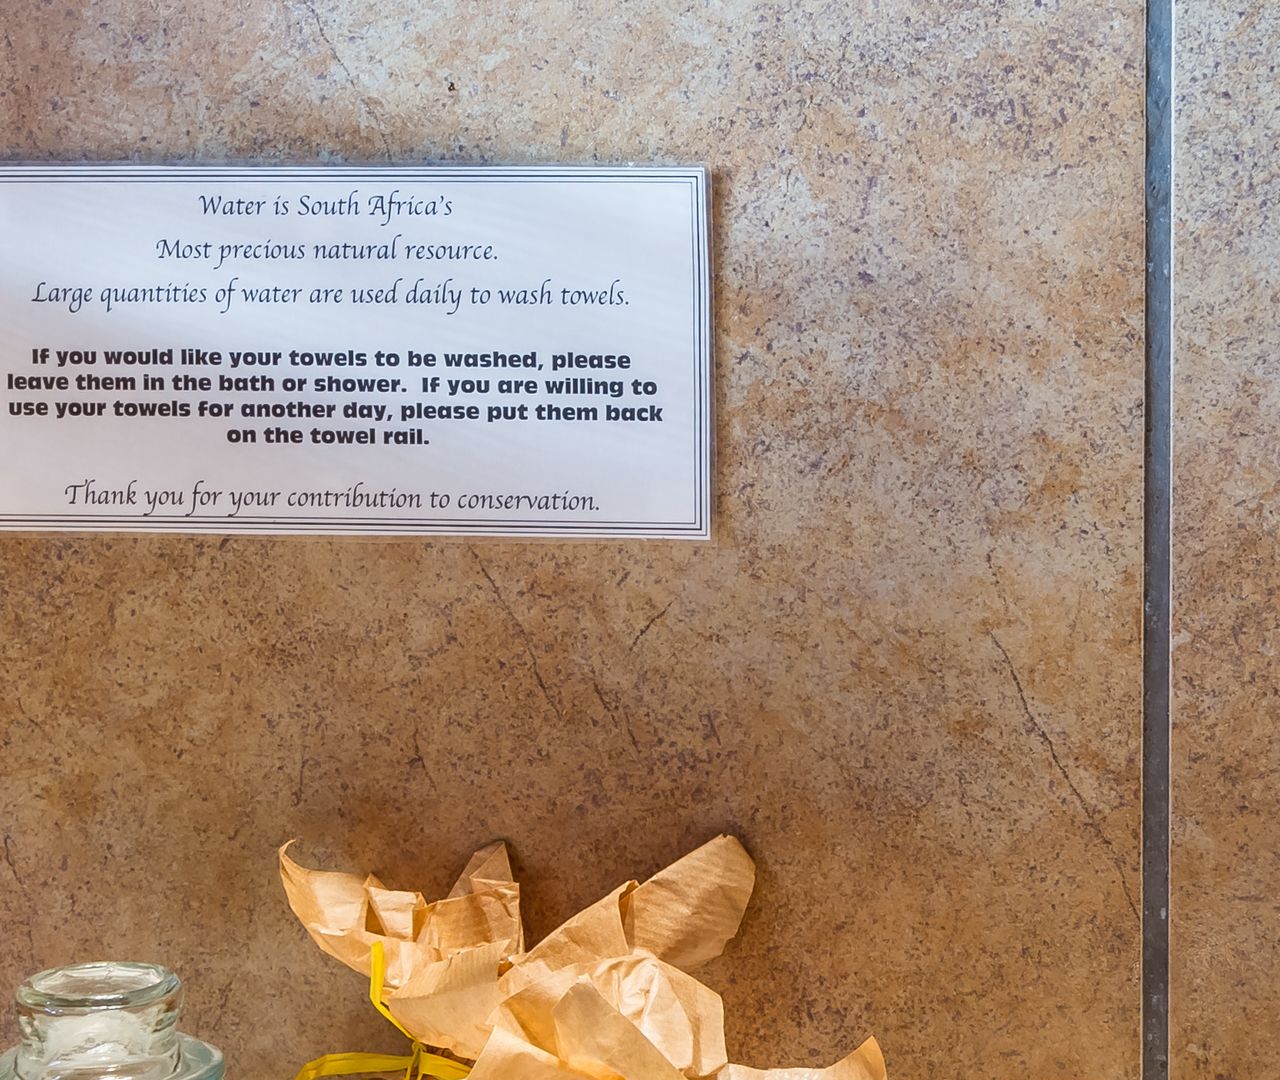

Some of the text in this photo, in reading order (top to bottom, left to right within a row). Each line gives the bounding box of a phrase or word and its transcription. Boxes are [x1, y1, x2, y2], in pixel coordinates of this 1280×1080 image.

[198, 189, 453, 227] Water is South Africa's
[155, 233, 498, 271] Most precious natural resource.
[30, 276, 629, 316] Large quantities of water are used daily to wash towels.
[31, 347, 632, 372] If you would like your towels to be washed, please
[7, 373, 658, 399] leave them in the bath or shower. If you are willing to
[8, 399, 664, 423] use your towels for another day, please put them back
[226, 426, 430, 446] on the towel rail.
[64, 478, 600, 518] Thank you for your contribution to conservation.
